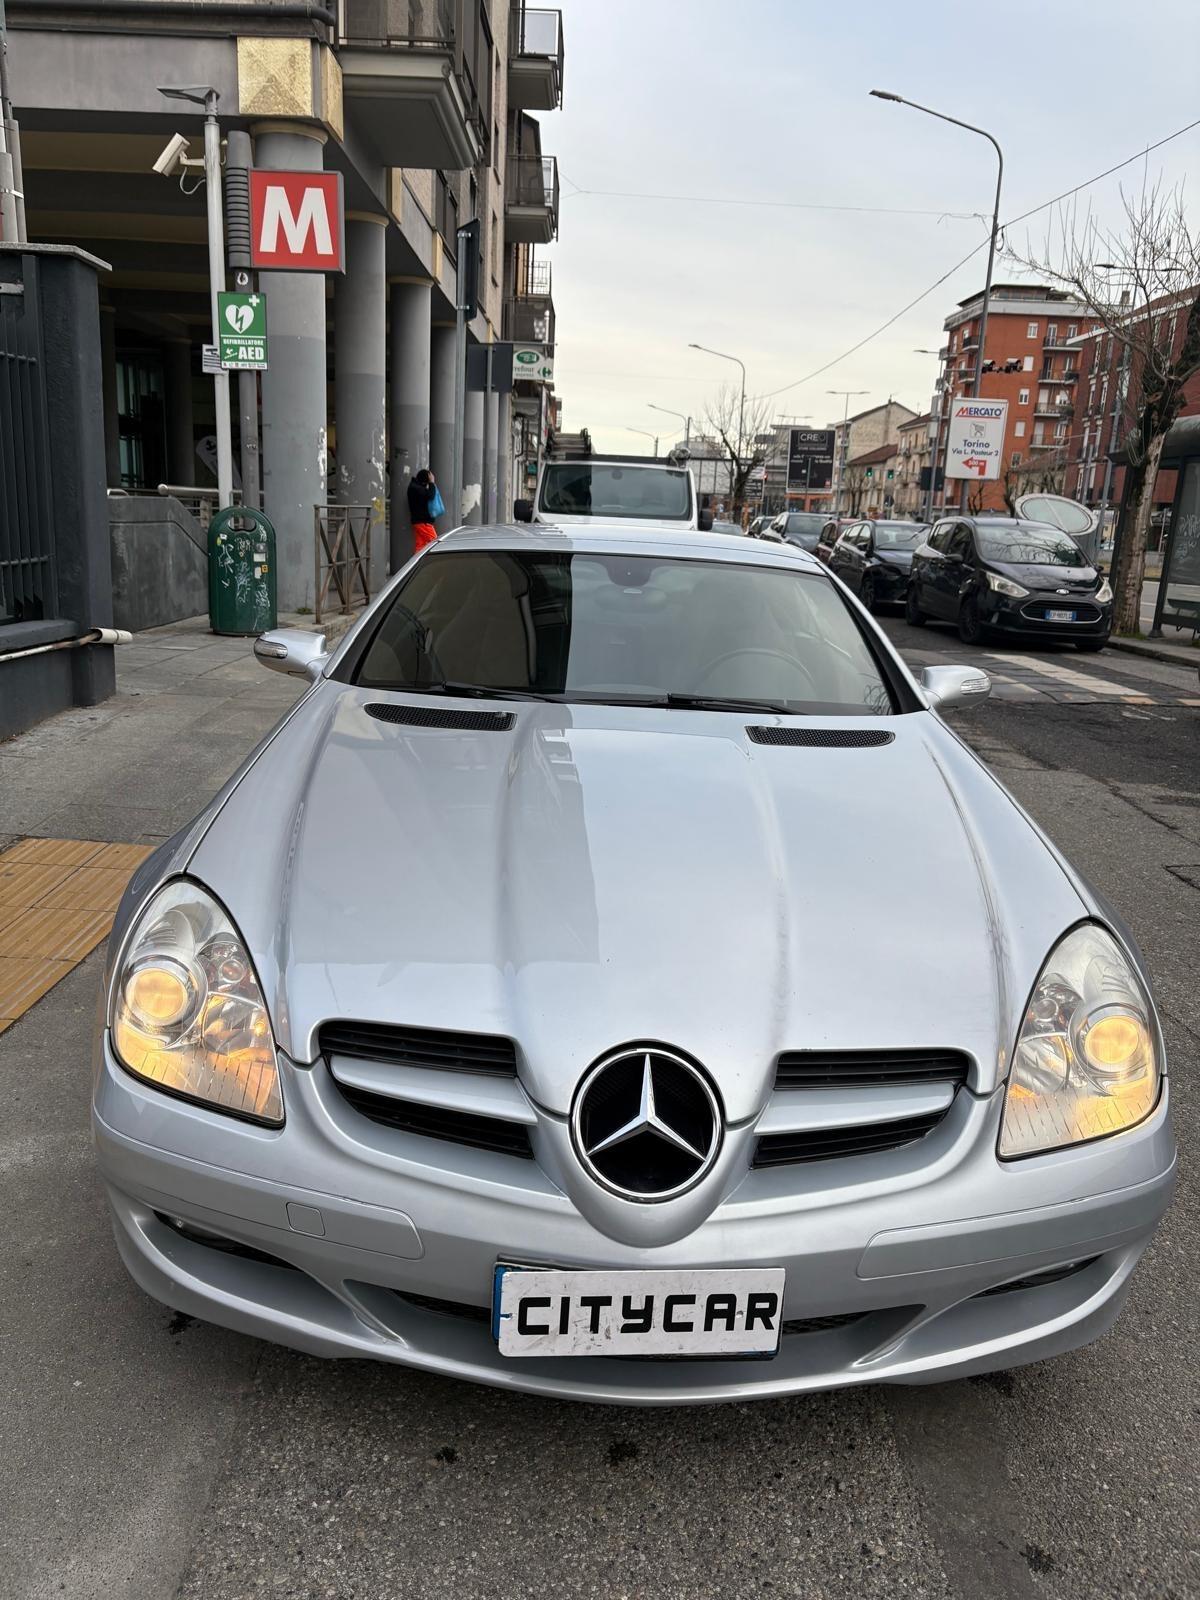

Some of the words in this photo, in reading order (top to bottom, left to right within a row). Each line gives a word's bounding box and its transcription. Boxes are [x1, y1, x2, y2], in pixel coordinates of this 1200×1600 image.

[260, 186, 333, 255] M
[238, 346, 264, 360] AED
[963, 439, 990, 448] Torino
[517, 1292, 778, 1335] CITYCAR
